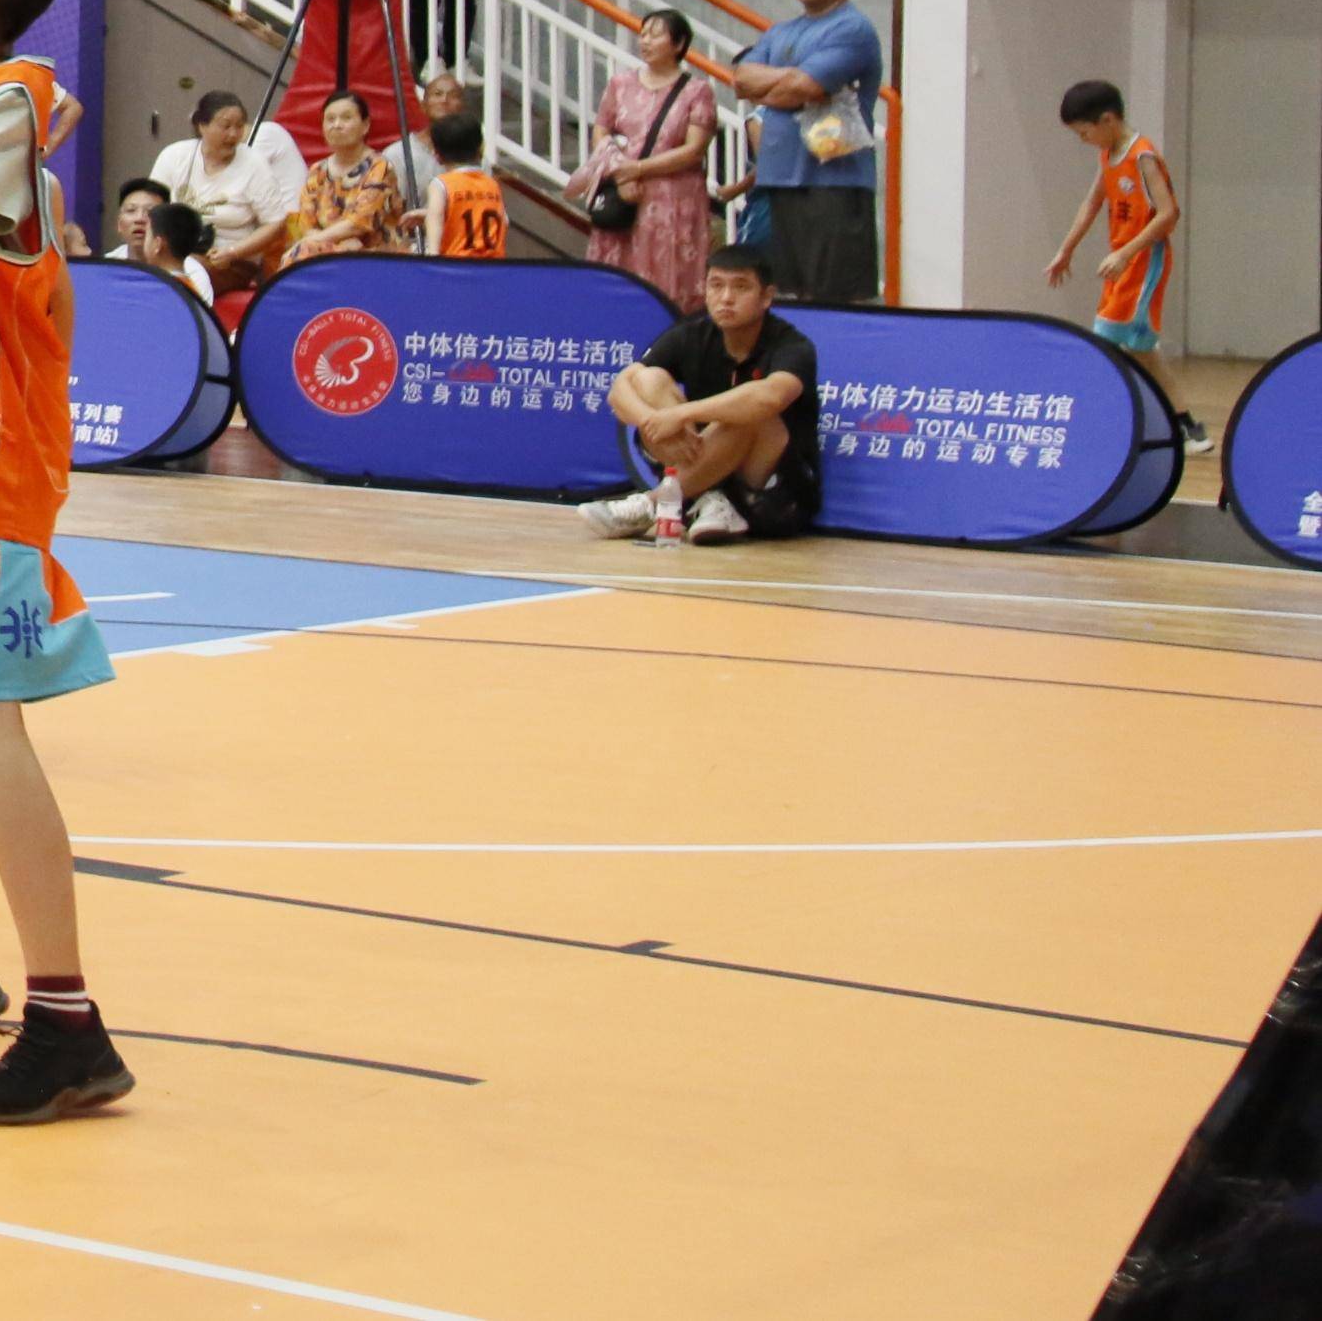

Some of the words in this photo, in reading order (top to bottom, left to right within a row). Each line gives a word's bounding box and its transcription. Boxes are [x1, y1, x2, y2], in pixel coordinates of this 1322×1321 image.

[462, 209, 502, 250] 10
[403, 331, 636, 367] 中体倍力运动生活馆
[499, 366, 555, 387] TOTAL
[402, 382, 613, 415] 您身边的运动专
[817, 381, 1074, 422] 中体倍力运动生活馆
[916, 419, 978, 440] TOTAL
[984, 422, 1067, 445] FITNESS
